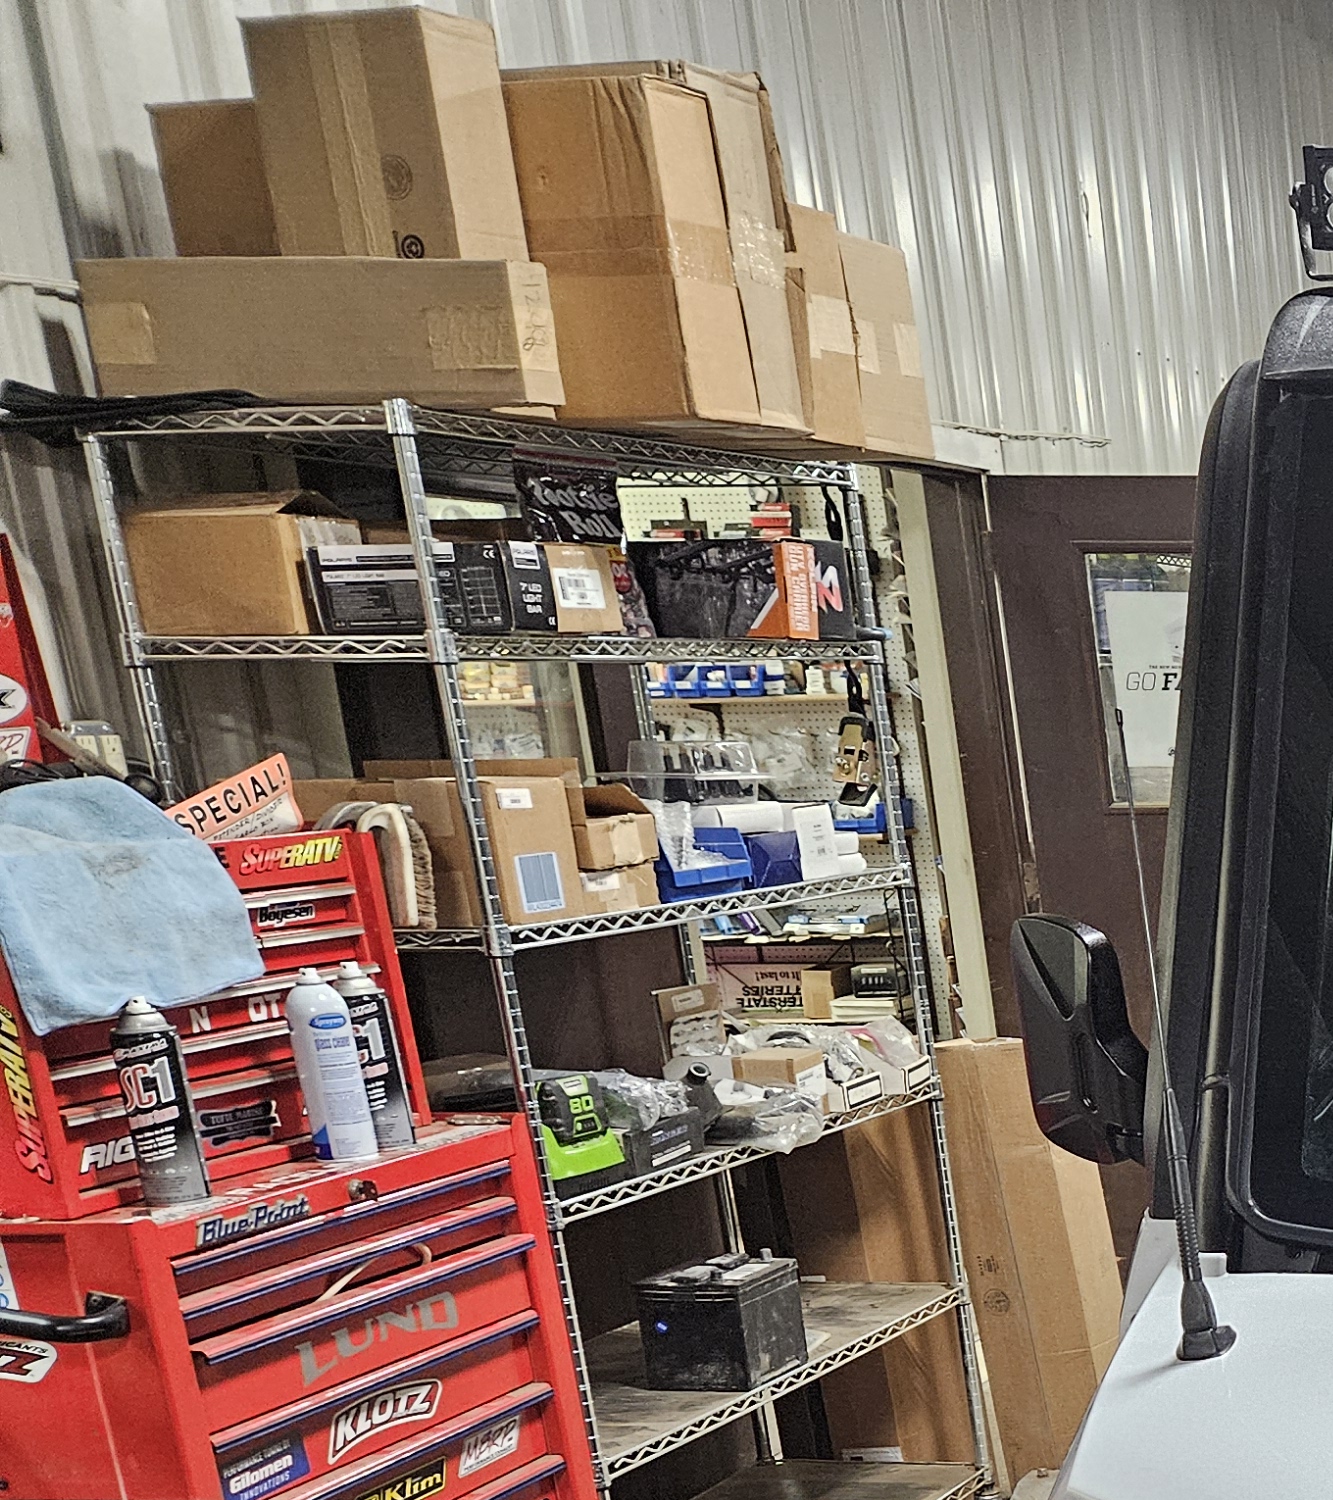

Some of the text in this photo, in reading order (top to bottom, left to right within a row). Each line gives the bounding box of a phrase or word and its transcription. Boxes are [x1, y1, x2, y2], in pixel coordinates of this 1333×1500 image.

[527, 477, 619, 511] Tootsie
[559, 510, 623, 539] Roll
[528, 582, 543, 593] LED
[526, 604, 543, 614] BAR
[1125, 671, 1157, 691] GO
[174, 762, 287, 836] SPECIAL!
[258, 904, 315, 925] Boyesen
[736, 997, 804, 1009] TERSTATE
[119, 1056, 176, 1112] SC1
[568, 1095, 594, 1114] 80
[79, 1135, 136, 1174] RIG
[0, 1339, 48, 1354] ICANTS
[294, 1290, 460, 1387] LUND
[335, 1383, 433, 1451] KLOTZ
[229, 1454, 294, 1495] Gilomen
